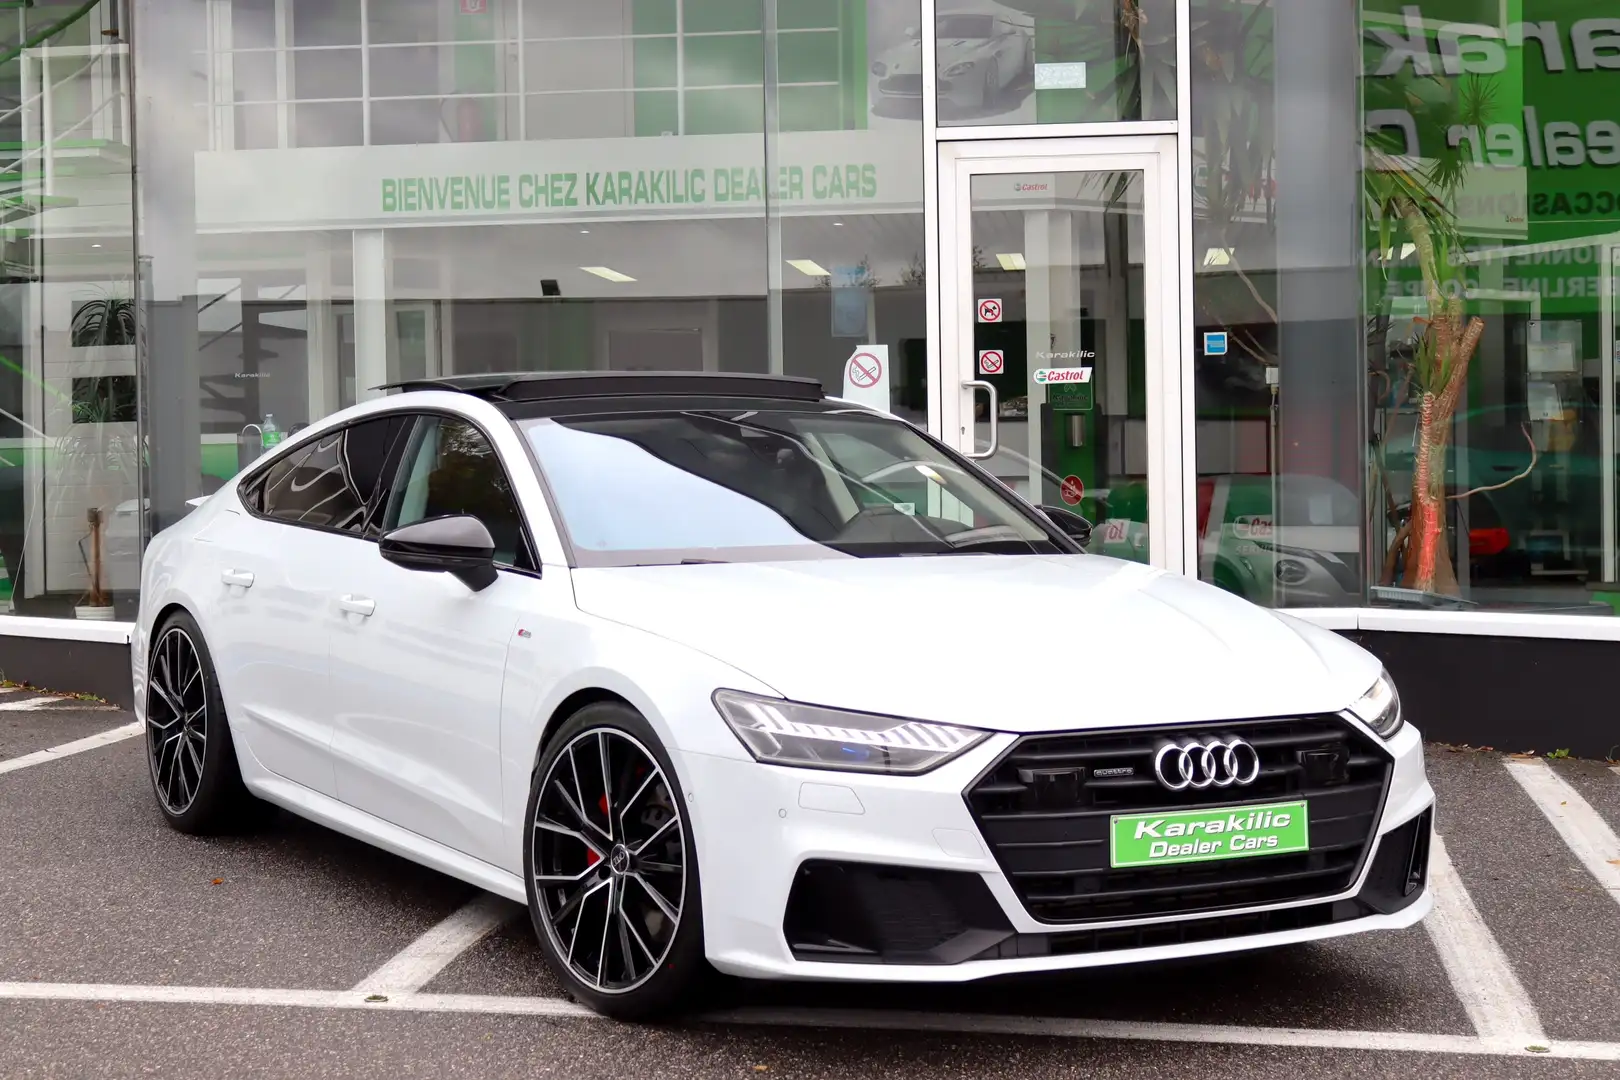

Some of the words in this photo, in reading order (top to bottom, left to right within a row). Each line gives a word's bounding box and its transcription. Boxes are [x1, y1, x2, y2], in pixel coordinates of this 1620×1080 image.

[382, 174, 510, 212] BIENVENUE
[518, 172, 578, 208] CHEZ
[586, 168, 706, 206] KARAKILIC
[714, 165, 803, 203] DEALER
[812, 164, 877, 200] CARS
[1035, 350, 1096, 359] Karakilic
[1048, 370, 1084, 381] Castrol
[1134, 811, 1291, 839] Karakilic
[1149, 839, 1222, 858] Dealer
[1229, 834, 1279, 851] Cars
